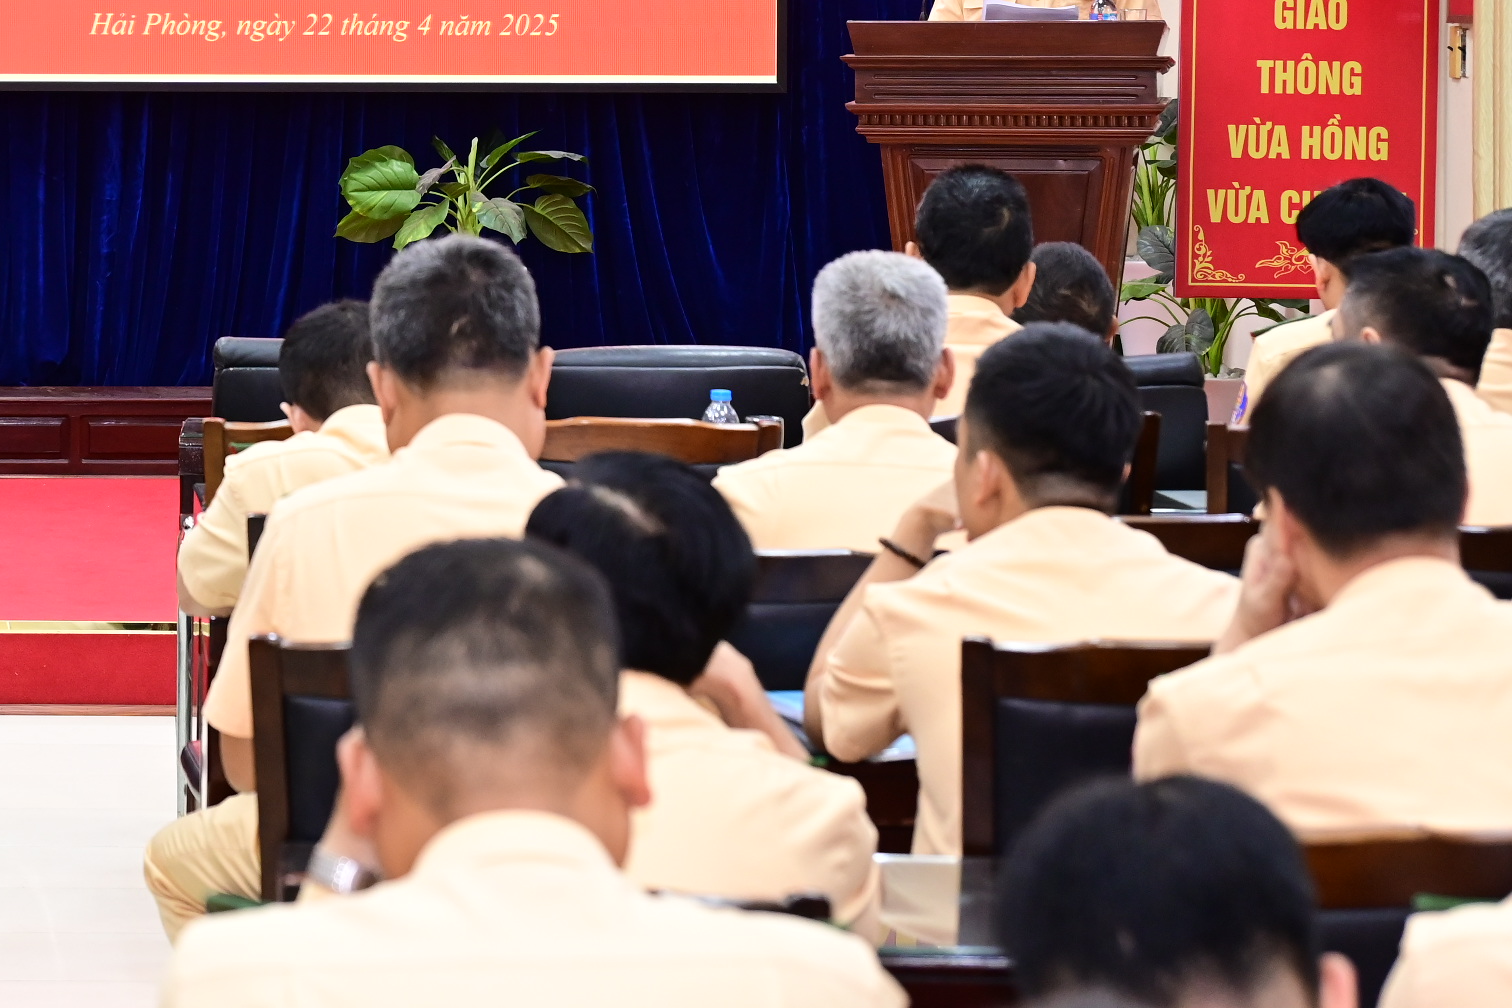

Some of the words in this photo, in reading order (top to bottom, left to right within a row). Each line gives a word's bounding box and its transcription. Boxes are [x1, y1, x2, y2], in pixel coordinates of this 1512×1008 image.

[90, 13, 135, 35] Hải
[143, 13, 225, 41] Phòng,
[237, 14, 295, 41] ngày
[303, 14, 332, 35] 22
[341, 13, 410, 42] tháng
[418, 14, 431, 35] 4
[440, 15, 490, 35] năm
[499, 14, 559, 36] 2025
[1257, 53, 1361, 95] THÔNG
[1228, 118, 1290, 158] VỪA
[1301, 114, 1388, 160] HỒNG
[1207, 182, 1269, 223] VỪA
